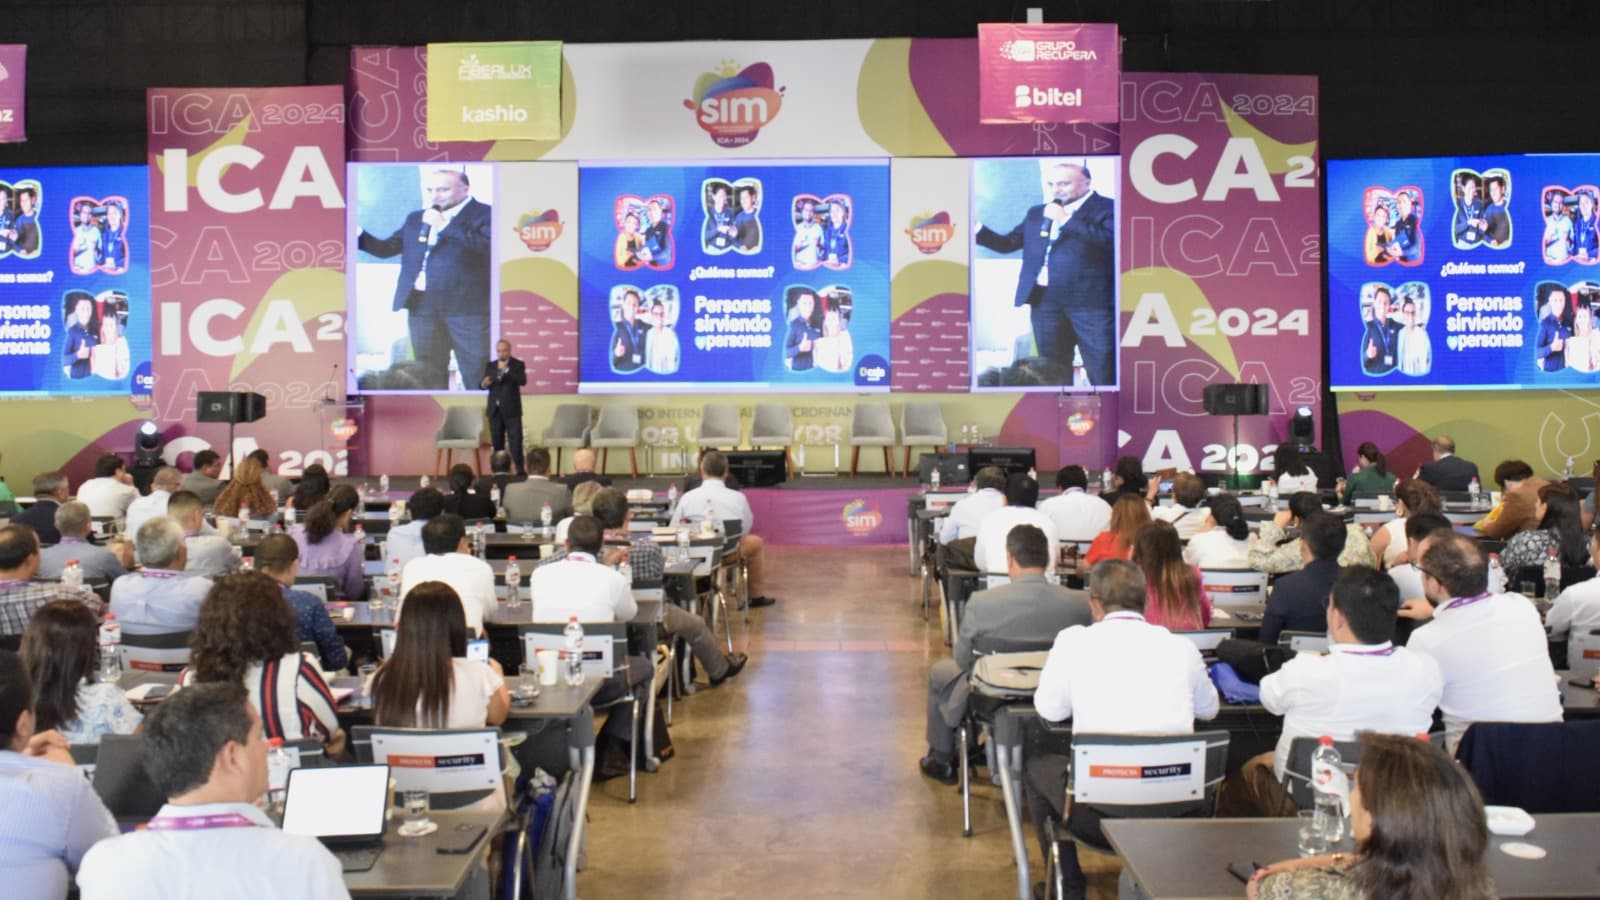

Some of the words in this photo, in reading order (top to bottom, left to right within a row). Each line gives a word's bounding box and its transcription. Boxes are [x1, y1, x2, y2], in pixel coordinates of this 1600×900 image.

[1036, 41, 1076, 51] GRUPO
[1036, 50, 1097, 61] RECUPERA
[1032, 88, 1082, 106] bitel
[1120, 80, 1230, 122] ICA
[1232, 95, 1316, 116] 2024
[152, 93, 262, 135] ICA
[262, 104, 345, 124] 2024
[463, 104, 528, 122] kashio
[701, 97, 767, 123] sim
[163, 145, 346, 214] ICA
[1284, 154, 1319, 188] 2
[522, 225, 557, 241] sim
[913, 228, 948, 243] sim
[1131, 214, 1298, 278] ICA
[1487, 261, 1525, 274] somos?
[694, 295, 772, 314] Personas
[1446, 293, 1523, 312] Personas
[161, 299, 314, 357] ICA
[317, 313, 346, 341] 2
[694, 314, 772, 333] sirviendo
[1189, 307, 1309, 337] 2024
[1446, 312, 1524, 332] sirviendo
[705, 334, 772, 352] personas
[1457, 333, 1524, 352] personas
[1288, 377, 1320, 404] 2
[1143, 766, 1182, 777] security
